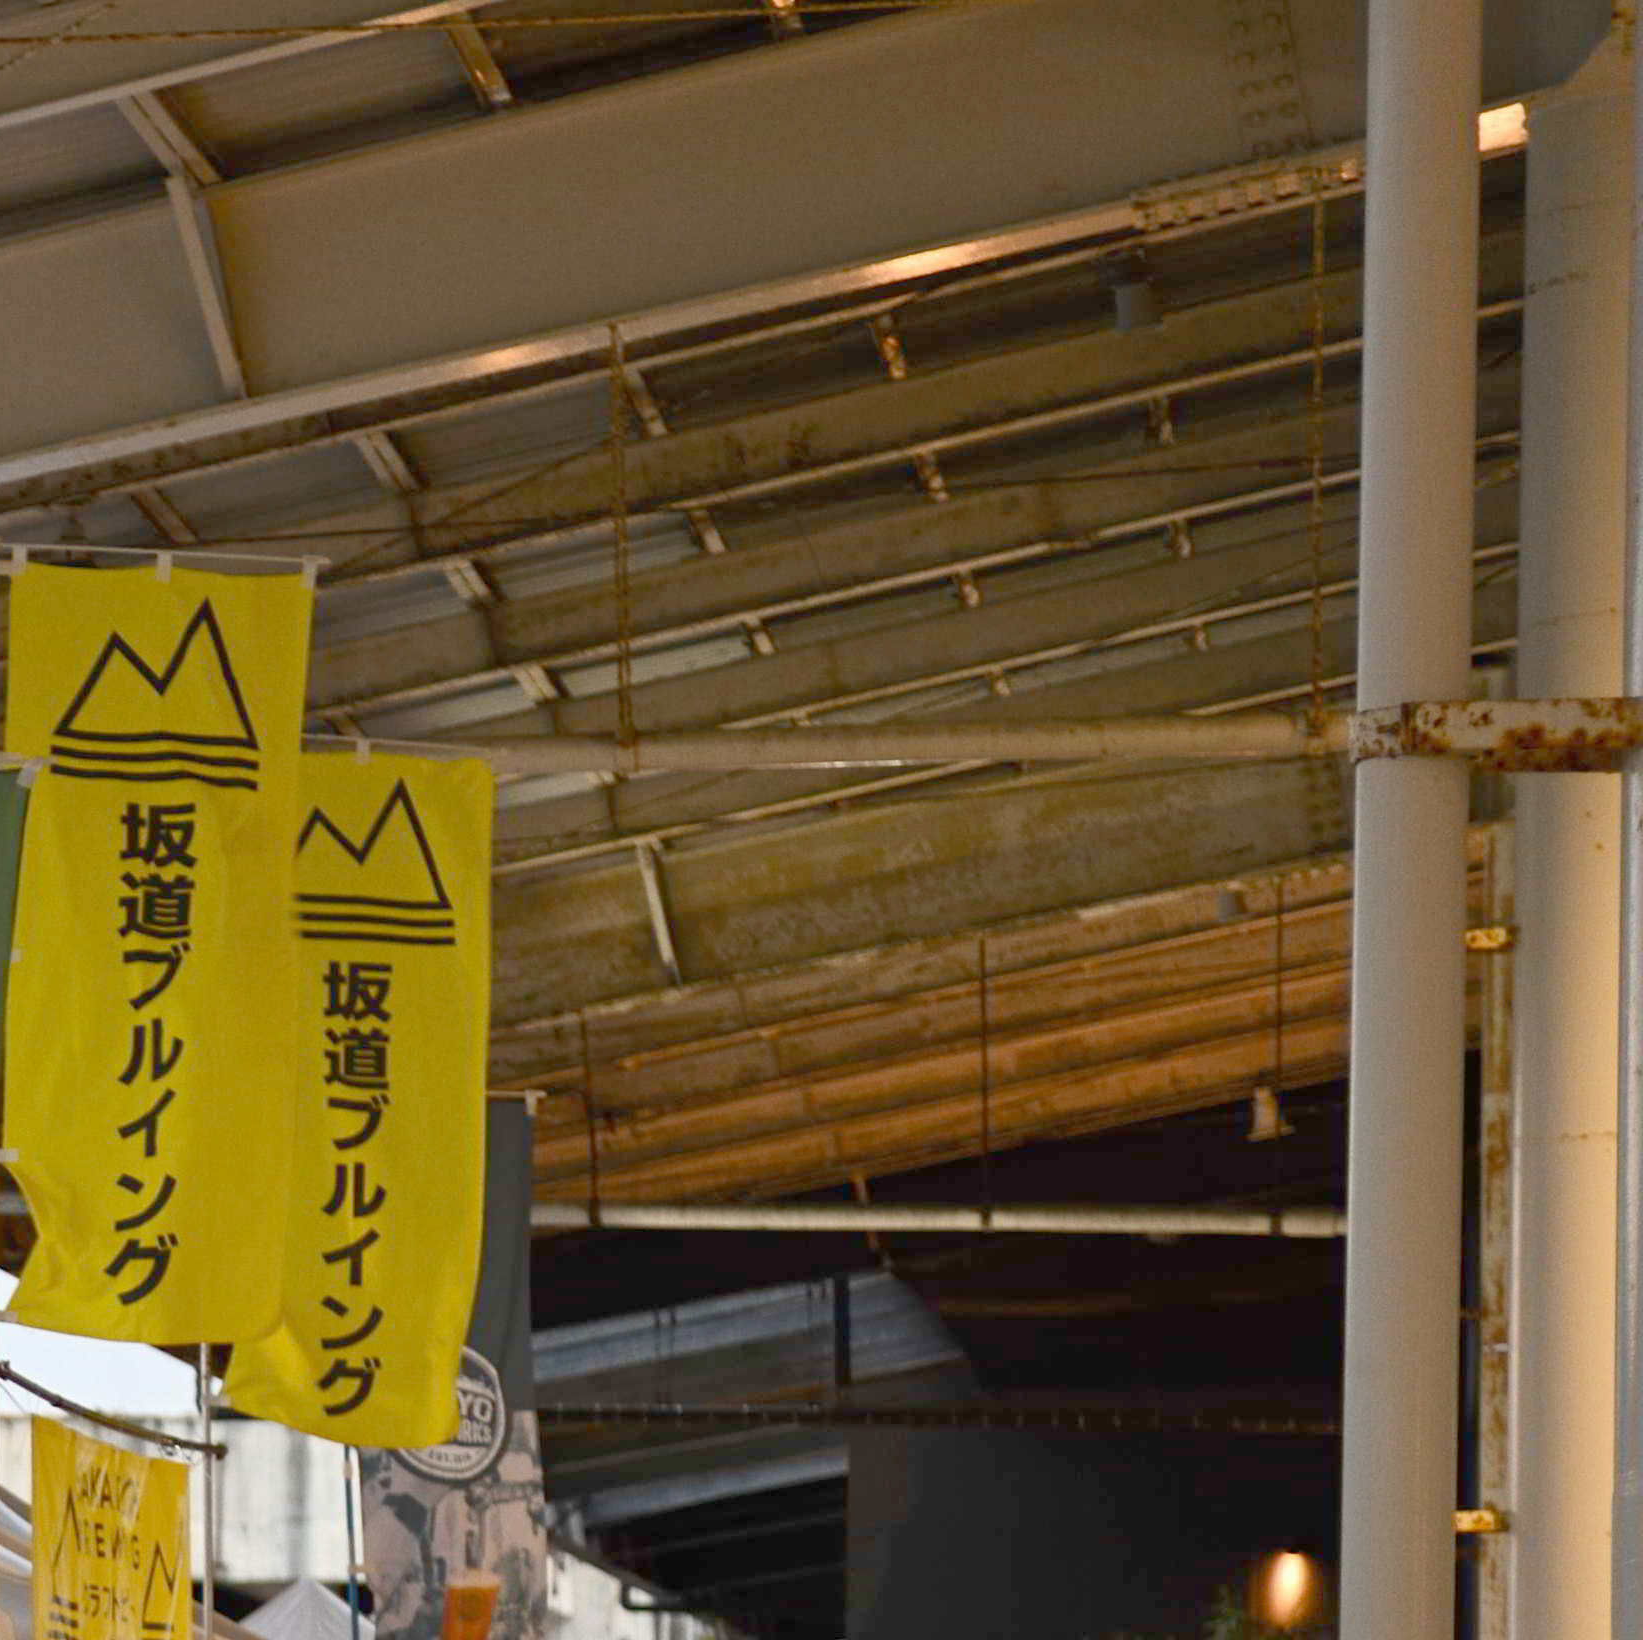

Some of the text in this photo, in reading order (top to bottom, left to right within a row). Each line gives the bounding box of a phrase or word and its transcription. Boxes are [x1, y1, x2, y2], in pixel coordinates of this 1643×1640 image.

[105, 803, 196, 1305] 坂道ブルイング
[318, 961, 392, 1416] 坂道ブルイング
